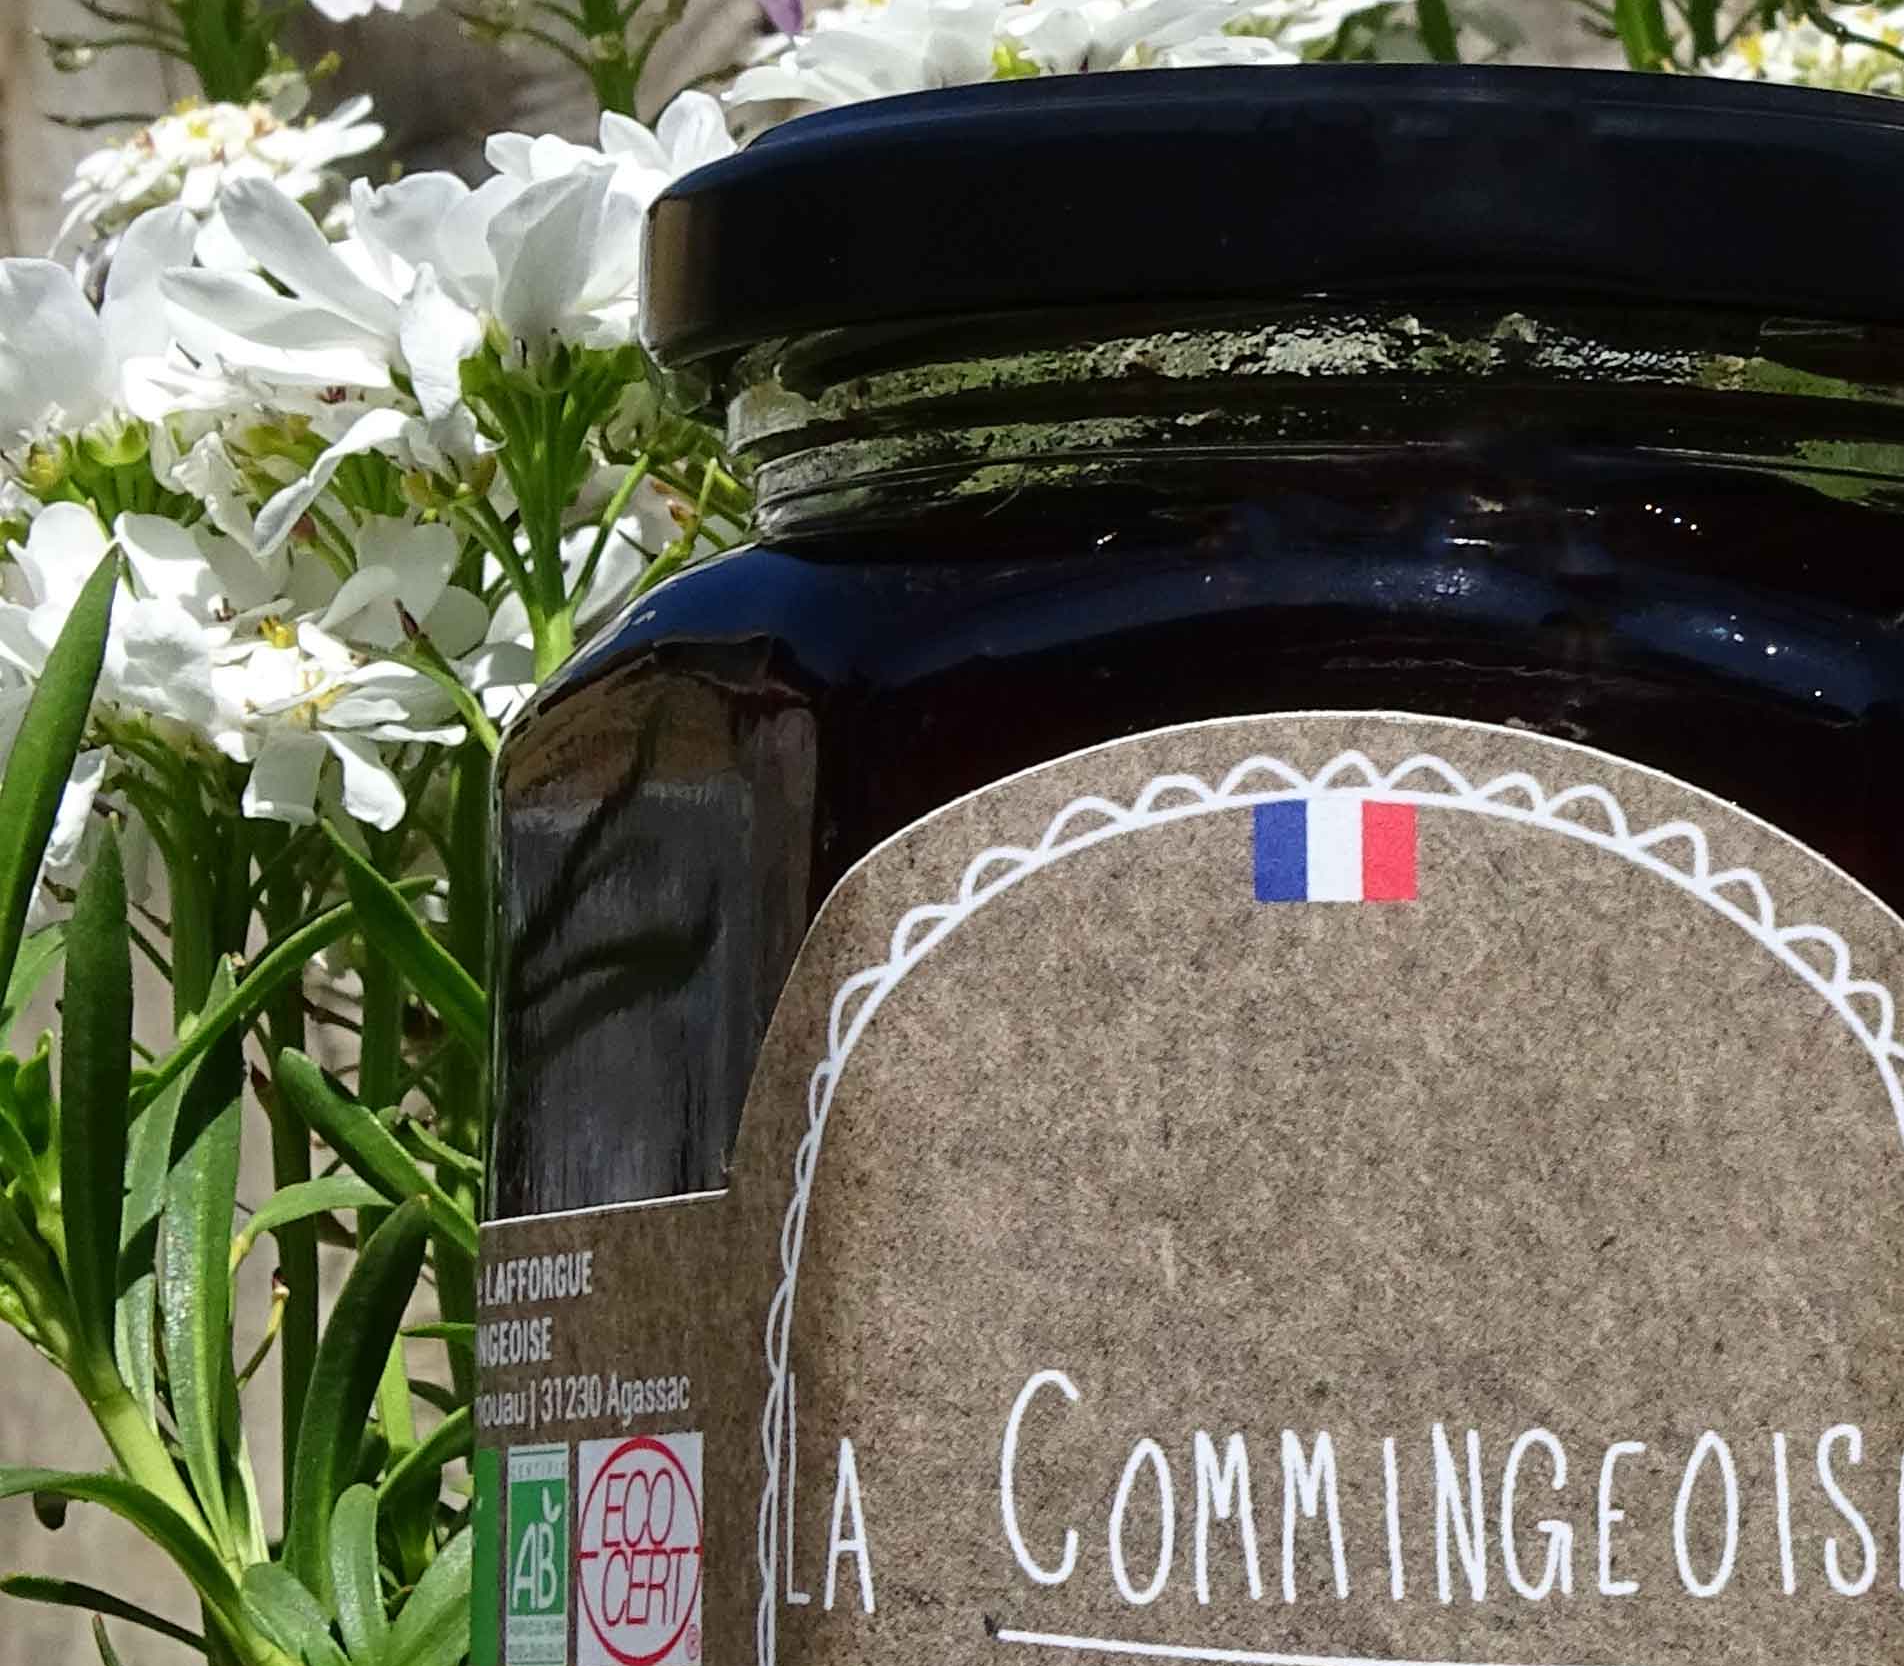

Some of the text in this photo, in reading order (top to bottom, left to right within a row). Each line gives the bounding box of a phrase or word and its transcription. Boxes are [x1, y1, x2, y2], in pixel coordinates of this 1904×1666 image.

[485, 1250, 594, 1306] LAFFORGUE
[540, 1374, 601, 1423] 31230
[606, 1370, 691, 1427] Agassac
[602, 1467, 675, 1548] ECO
[787, 1372, 875, 1614] LA
[512, 1522, 558, 1610] AB
[601, 1546, 691, 1627] CERT
